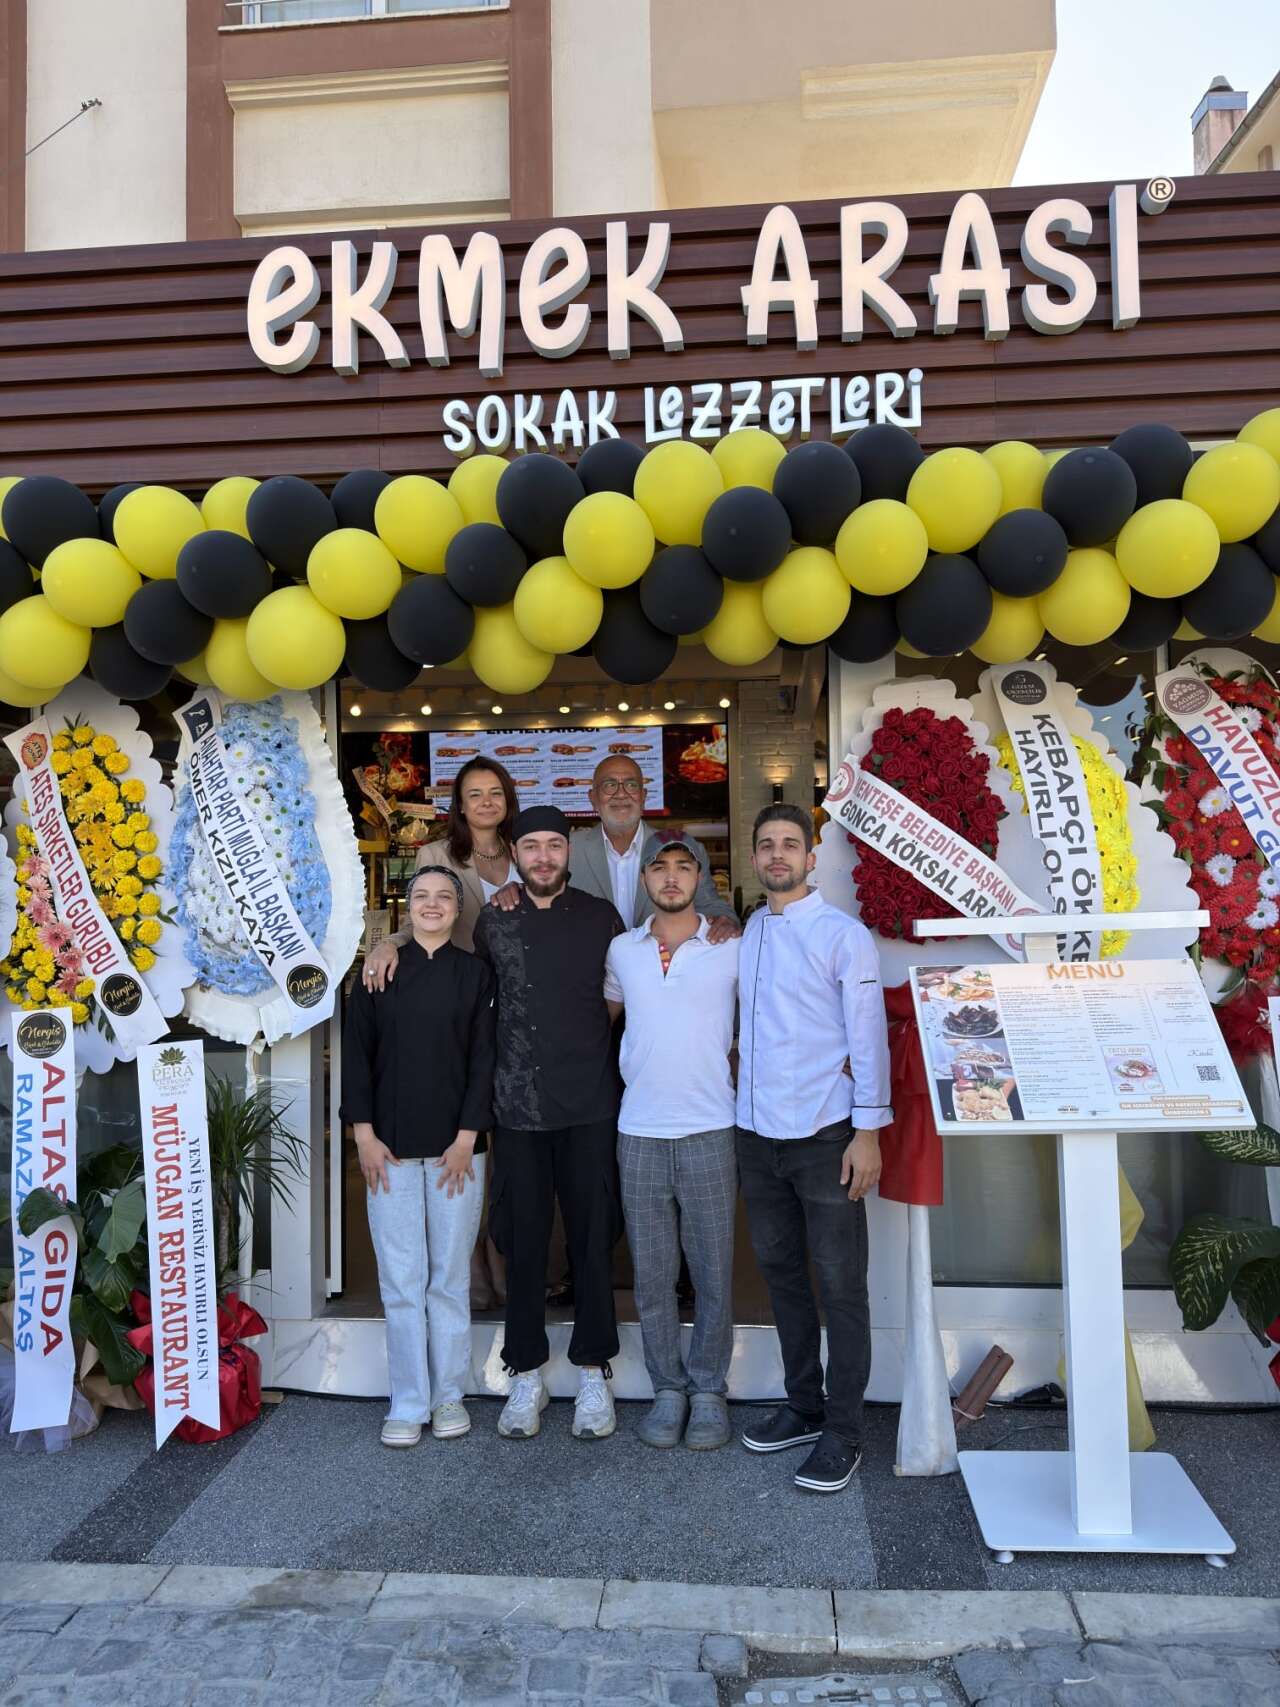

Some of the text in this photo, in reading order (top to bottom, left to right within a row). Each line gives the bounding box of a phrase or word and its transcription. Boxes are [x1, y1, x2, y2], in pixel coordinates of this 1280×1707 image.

[740, 184, 1141, 351] ARASI
[443, 390, 621, 456] SOKAK
[200, 732, 229, 796] ANAHTAR
[211, 791, 253, 834] PARTİ
[1014, 729, 1058, 839] HAYIRLI
[1032, 713, 1087, 855] KEBAPÇI
[1186, 724, 1264, 821] DAVUT
[31, 768, 120, 976] ATEŞ ŞİRKETLER GURUBU
[189, 751, 276, 967] ÖMER KIZILKAYA
[247, 875, 277, 900] İL
[839, 800, 1006, 918] GONCA KÖKSAL ARA
[852, 775, 1018, 913] MENTEŞE BELEDİYE BAŞKANI
[254, 892, 307, 961] BAŞKANI
[1047, 962, 1125, 980] MENÜ
[152, 1064, 195, 1084] PERA
[151, 1103, 187, 1222] MÜJGAN
[15, 1245, 36, 1352] ALTAŞ
[40, 1230, 69, 1357] GIDA
[188, 1137, 209, 1381] YENİ İŞ YERİNİZ HAYIRLI OLSUN
[158, 1228, 191, 1411] RESTAURANT
